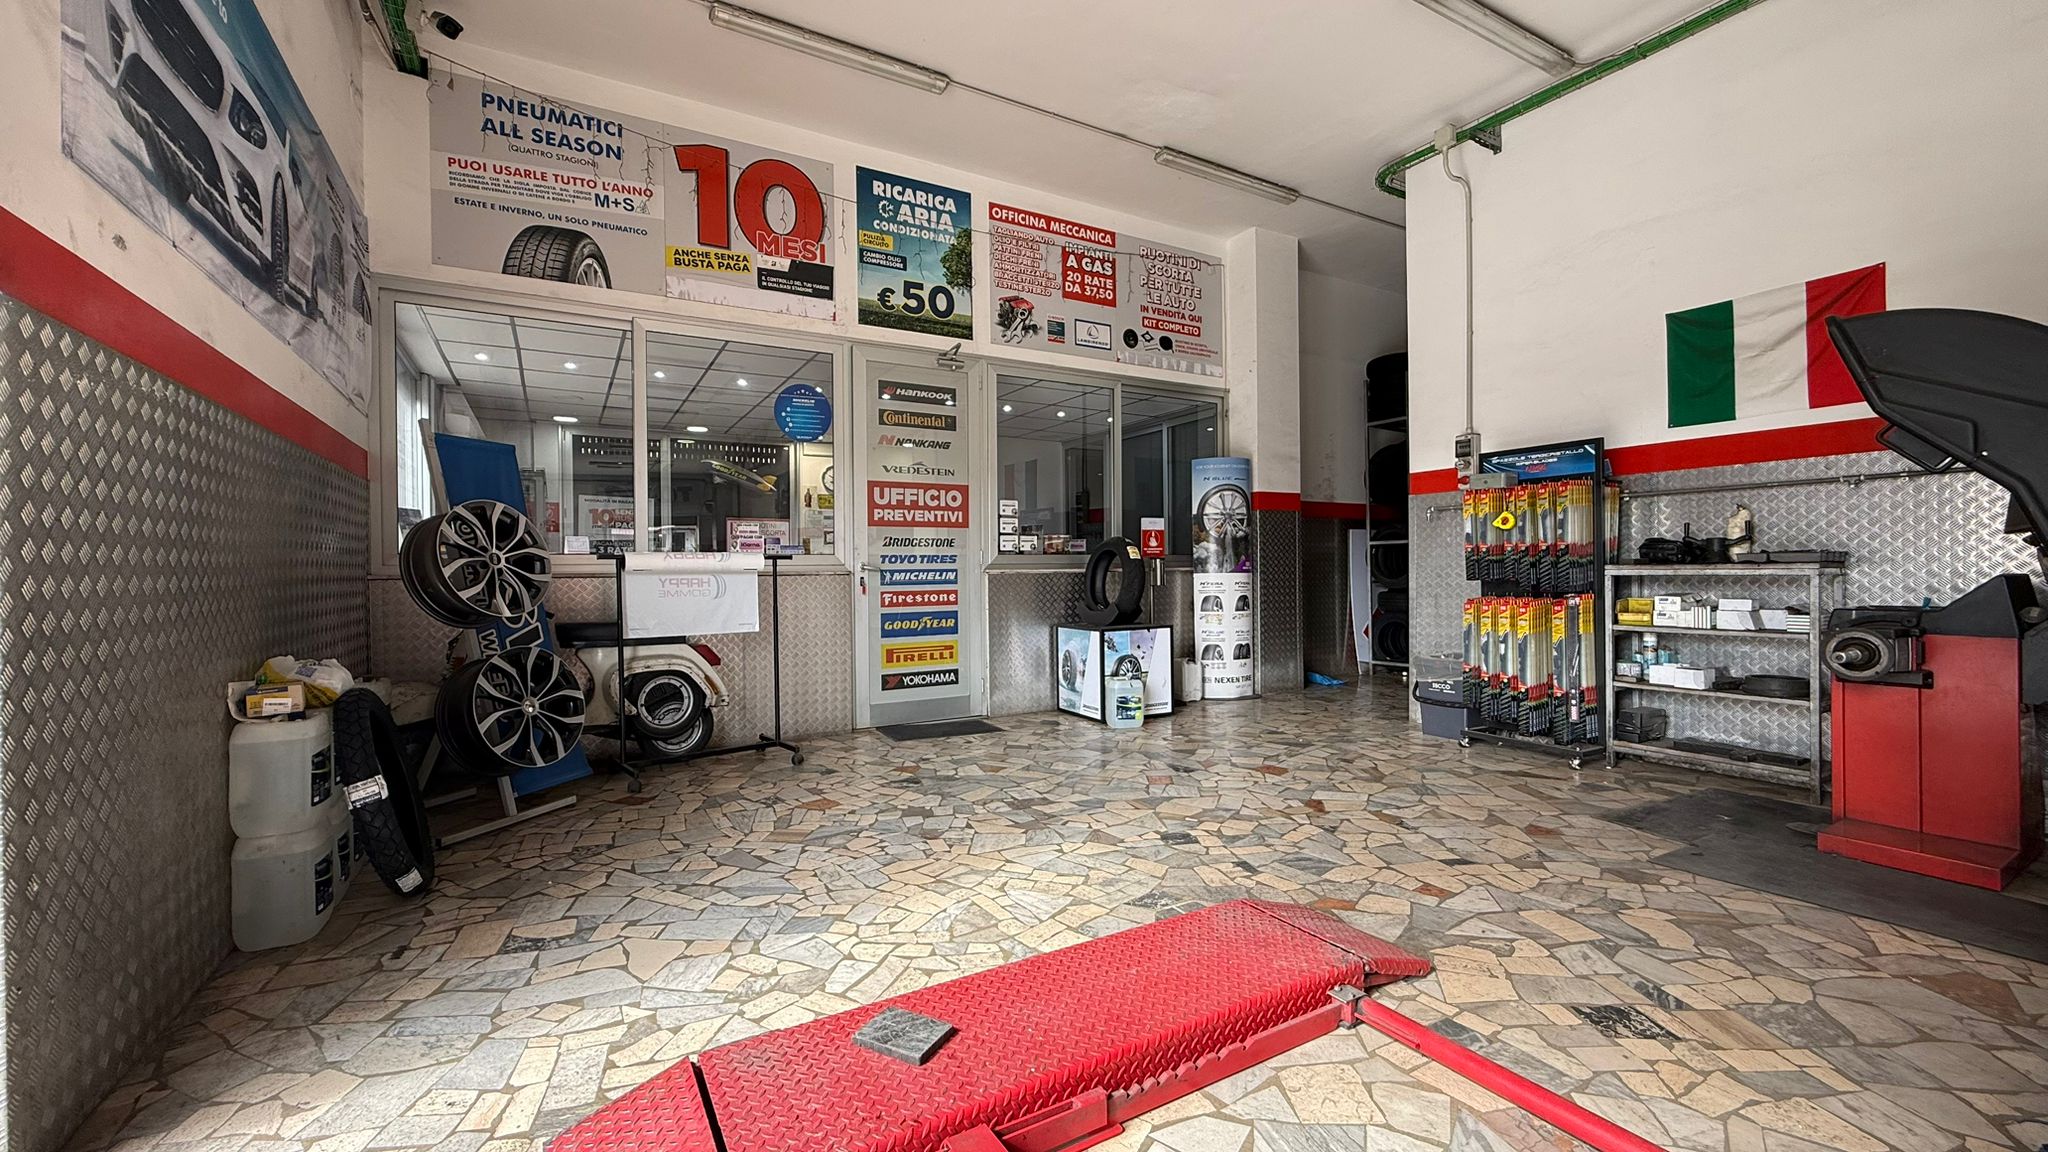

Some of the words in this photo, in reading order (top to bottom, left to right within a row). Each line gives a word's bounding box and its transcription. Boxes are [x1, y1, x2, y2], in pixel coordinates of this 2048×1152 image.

[481, 92, 623, 138] PNEUMATICI
[481, 117, 524, 140] ALL
[531, 127, 623, 161] SEASON
[508, 143, 553, 159] (QUATTRO
[447, 157, 487, 173] PUOI
[493, 164, 548, 182] USARLE
[552, 173, 597, 189] TUTTO
[602, 181, 654, 198] L'ANNO
[594, 192, 635, 212] M+S
[673, 143, 825, 252] 10
[872, 179, 957, 214] RICARICA
[454, 196, 487, 209] ESTATE
[498, 204, 545, 219] INVERNO,
[547, 213, 562, 221] UN
[564, 216, 589, 226] SOLO
[591, 220, 648, 236] PNEUMATICO
[896, 203, 955, 233] ARIA
[873, 219, 957, 246] CONDIZIONATA
[991, 207, 1047, 230] OFFICINA
[1049, 220, 1113, 245] MECCANICA
[993, 225, 1034, 241] TAGLIANDO
[1035, 235, 1055, 246] AUTO
[863, 232, 885, 242] PULIZIA
[863, 238, 890, 249] CIRCUITO
[993, 234, 1011, 245] OLIO
[1012, 237, 1017, 245] E
[1018, 239, 1040, 252] FILTRI
[673, 248, 711, 259] ANCHE
[714, 252, 749, 263] SENZA
[756, 230, 826, 264] MESI
[863, 250, 886, 260] CAMBIO
[993, 243, 1020, 256] PATTINI
[1021, 248, 1043, 260] FRENI
[1065, 241, 1113, 261] IMPIANTI
[674, 257, 714, 269] BUSTA
[717, 262, 751, 272] PAGA
[863, 256, 904, 269] COMPRESSORE
[993, 252, 1019, 264] DISCHI
[1019, 257, 1040, 269] FRENI
[1066, 254, 1079, 269] A
[1081, 258, 1113, 276] GAS
[1139, 246, 1188, 268] RUOTINI
[1189, 257, 1202, 271] DI
[993, 261, 1057, 281] AMMORTIZZATORI
[993, 270, 1033, 285] BRACCETTI
[1034, 278, 1061, 290] STERZO
[1066, 271, 1081, 282] 20
[1084, 274, 1113, 289] RATE
[1148, 262, 1195, 284] SCORTA
[994, 280, 1023, 293] TESTINE
[1024, 285, 1052, 297] STERZO
[1065, 281, 1082, 293] DA
[1084, 285, 1113, 300] 37,50
[1140, 275, 1164, 291] PER
[1165, 281, 1202, 299] TUTTE
[1147, 291, 1161, 305] LE
[1163, 295, 1196, 312] AUTO
[1140, 304, 1149, 314] IN
[1151, 306, 1187, 320] VENDITA
[1188, 313, 1203, 324] QUI
[1143, 317, 1157, 328] KIT
[1158, 320, 1200, 336] COMPLETO
[883, 410, 945, 428] Continental
[881, 464, 955, 477] VREDESTEIN
[873, 486, 963, 508] UFFICIO
[873, 508, 963, 523] PREVENTIVI
[597, 545, 605, 554] 3
[882, 536, 956, 548] BRIDGESTONE
[880, 554, 917, 564] TOYO
[918, 554, 958, 564] TIRES
[892, 571, 956, 581] MICHELIN
[882, 592, 957, 606] Firestone
[884, 616, 956, 631] GOODYEAR
[885, 644, 955, 664] PIRELLI
[902, 672, 956, 686] YOKOHAMA
[1214, 676, 1240, 684] NEXEN
[1240, 674, 1253, 683] TIRE
